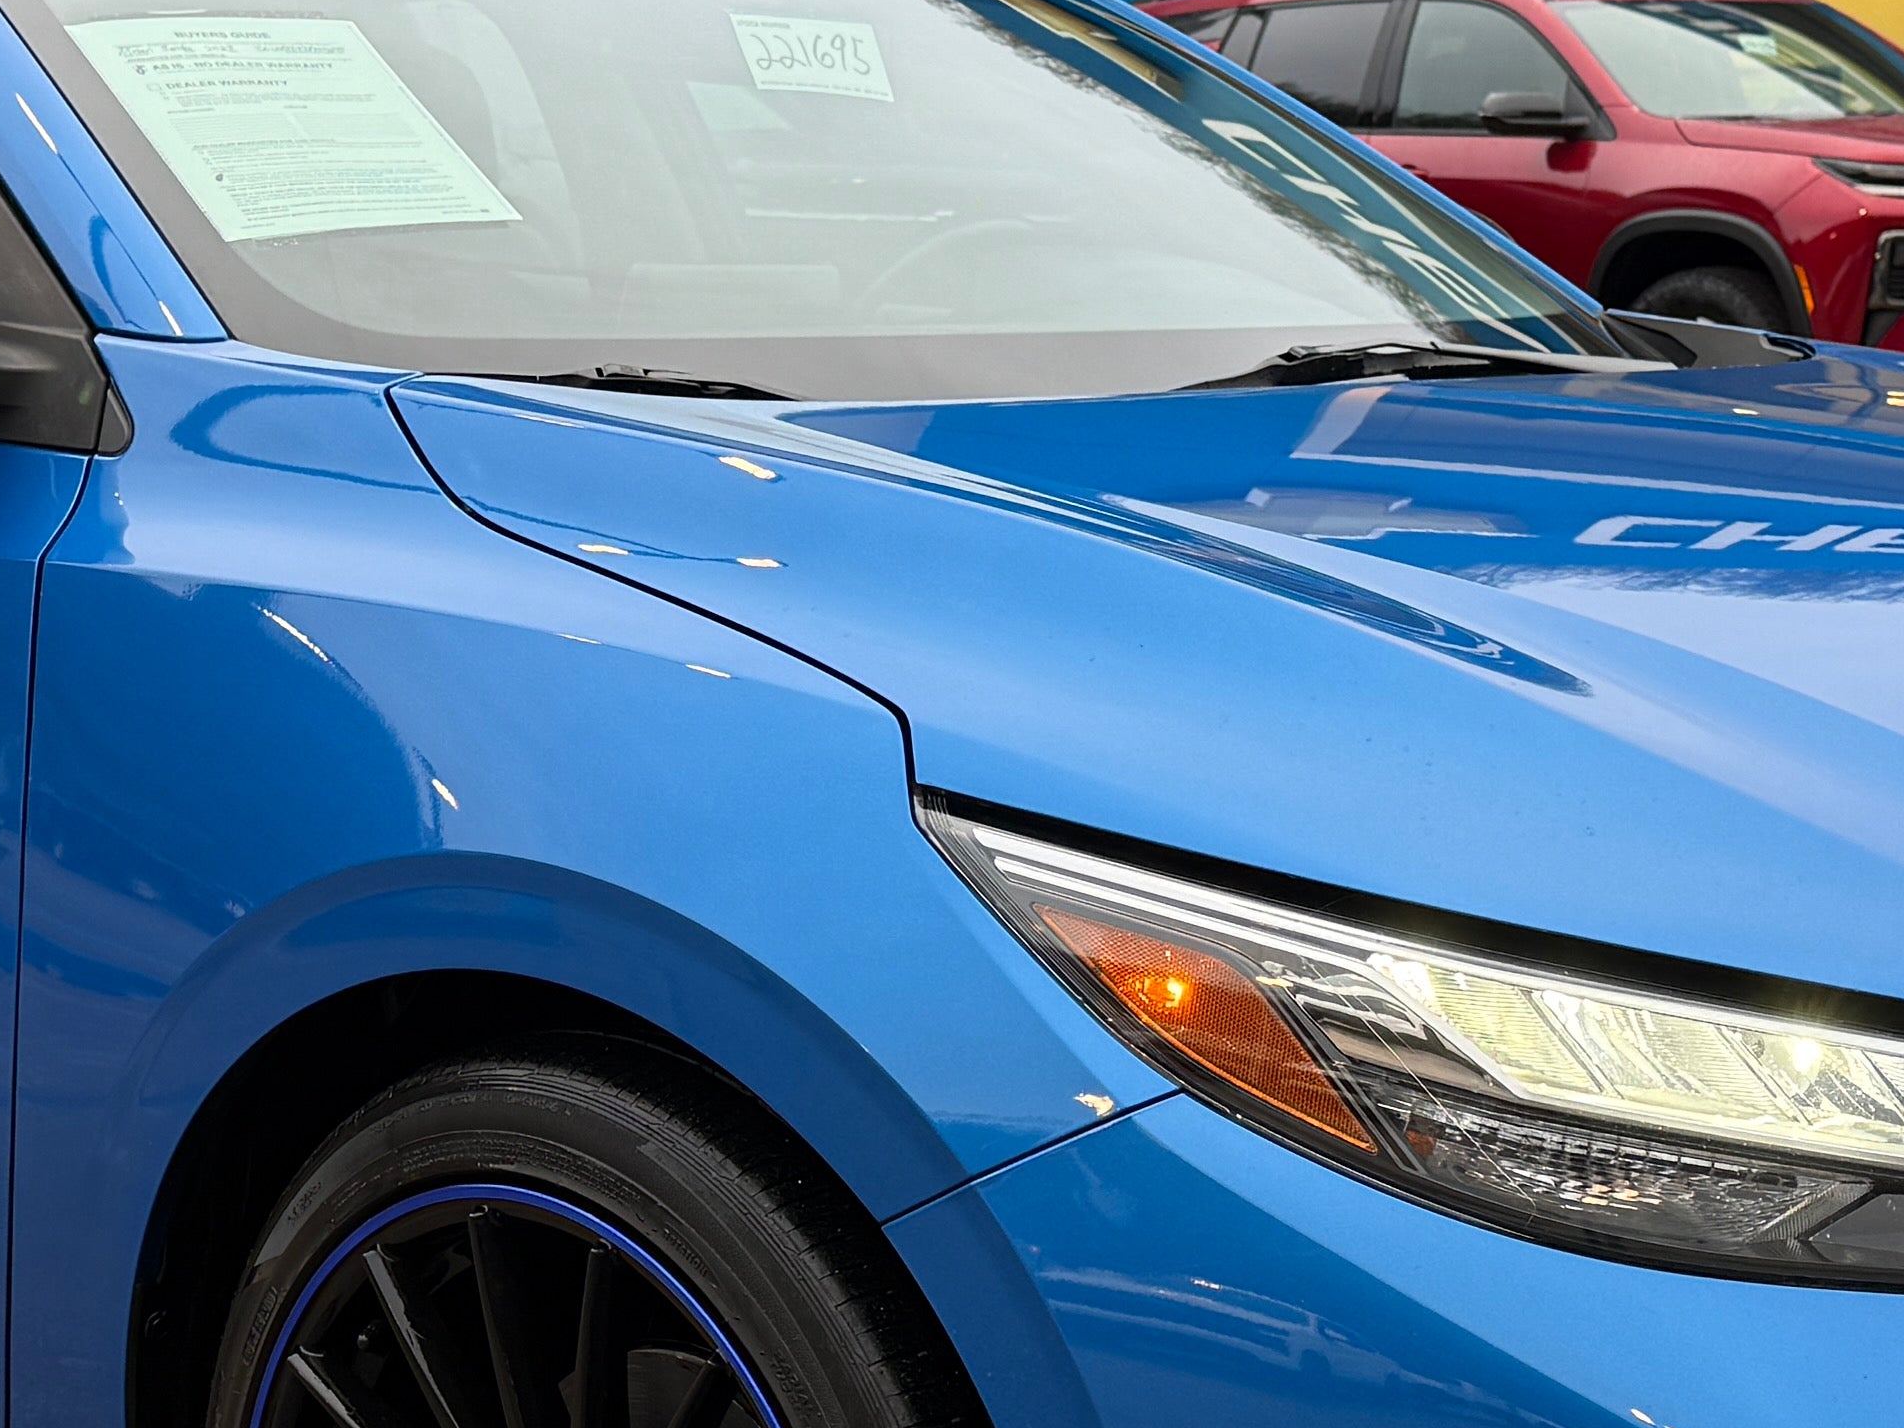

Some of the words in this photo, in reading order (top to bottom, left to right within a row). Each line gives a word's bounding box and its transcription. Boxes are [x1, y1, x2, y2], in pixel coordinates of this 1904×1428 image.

[230, 31, 271, 39] GUIDE
[749, 33, 871, 75] 221695
[215, 60, 264, 68] DEALER
[266, 61, 332, 69] WARRANTY
[166, 81, 217, 90] DEALER
[218, 79, 287, 87] WARRANTY
